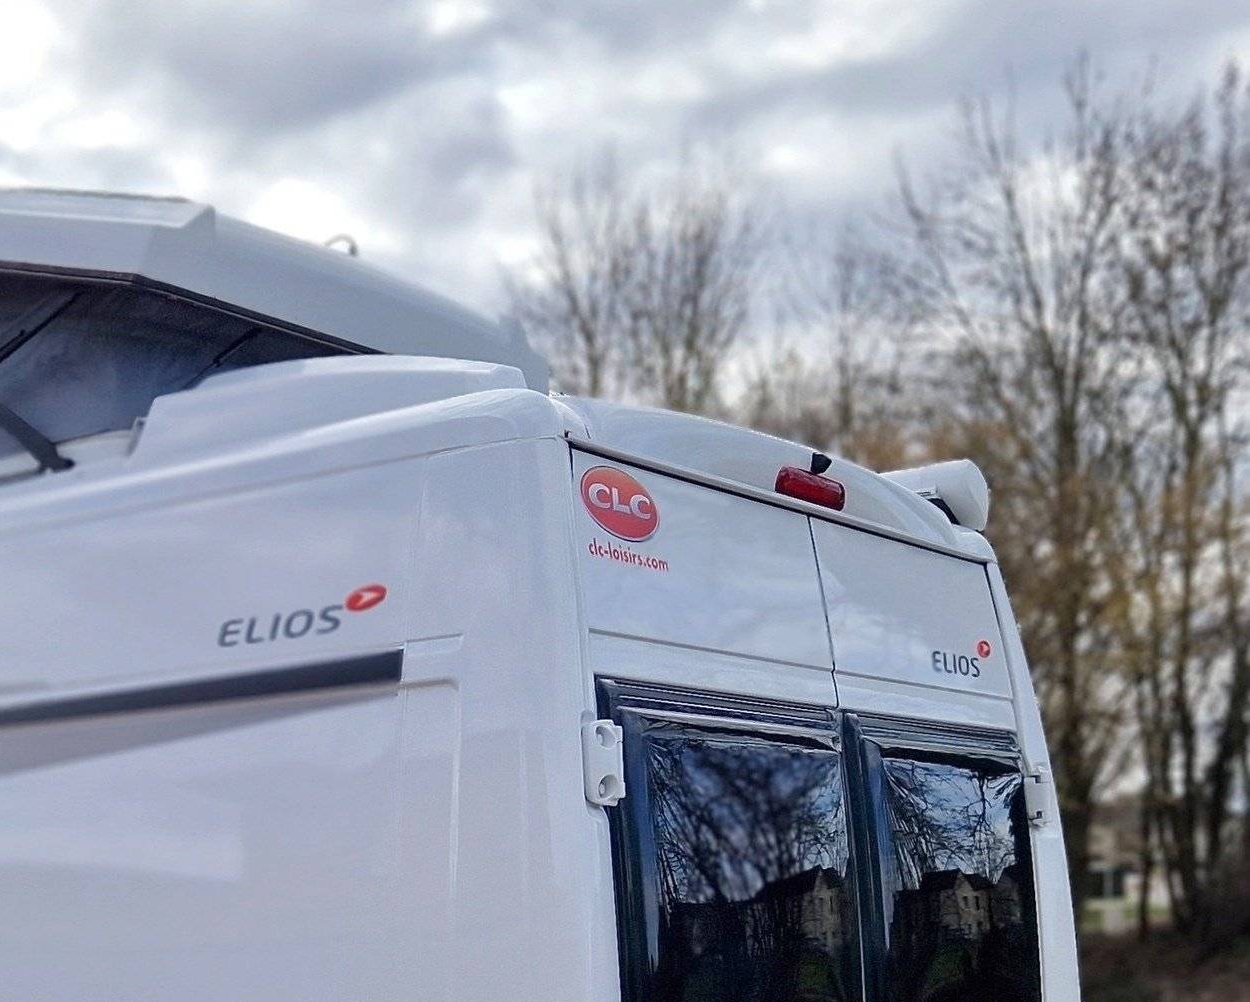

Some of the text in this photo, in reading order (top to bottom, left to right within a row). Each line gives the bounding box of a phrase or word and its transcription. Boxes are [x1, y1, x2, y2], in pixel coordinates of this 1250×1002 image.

[588, 483, 651, 520] CLC
[588, 538, 669, 573] clc-loisirs.com
[217, 604, 344, 647] ELIOS
[932, 650, 981, 678] ELIOS
